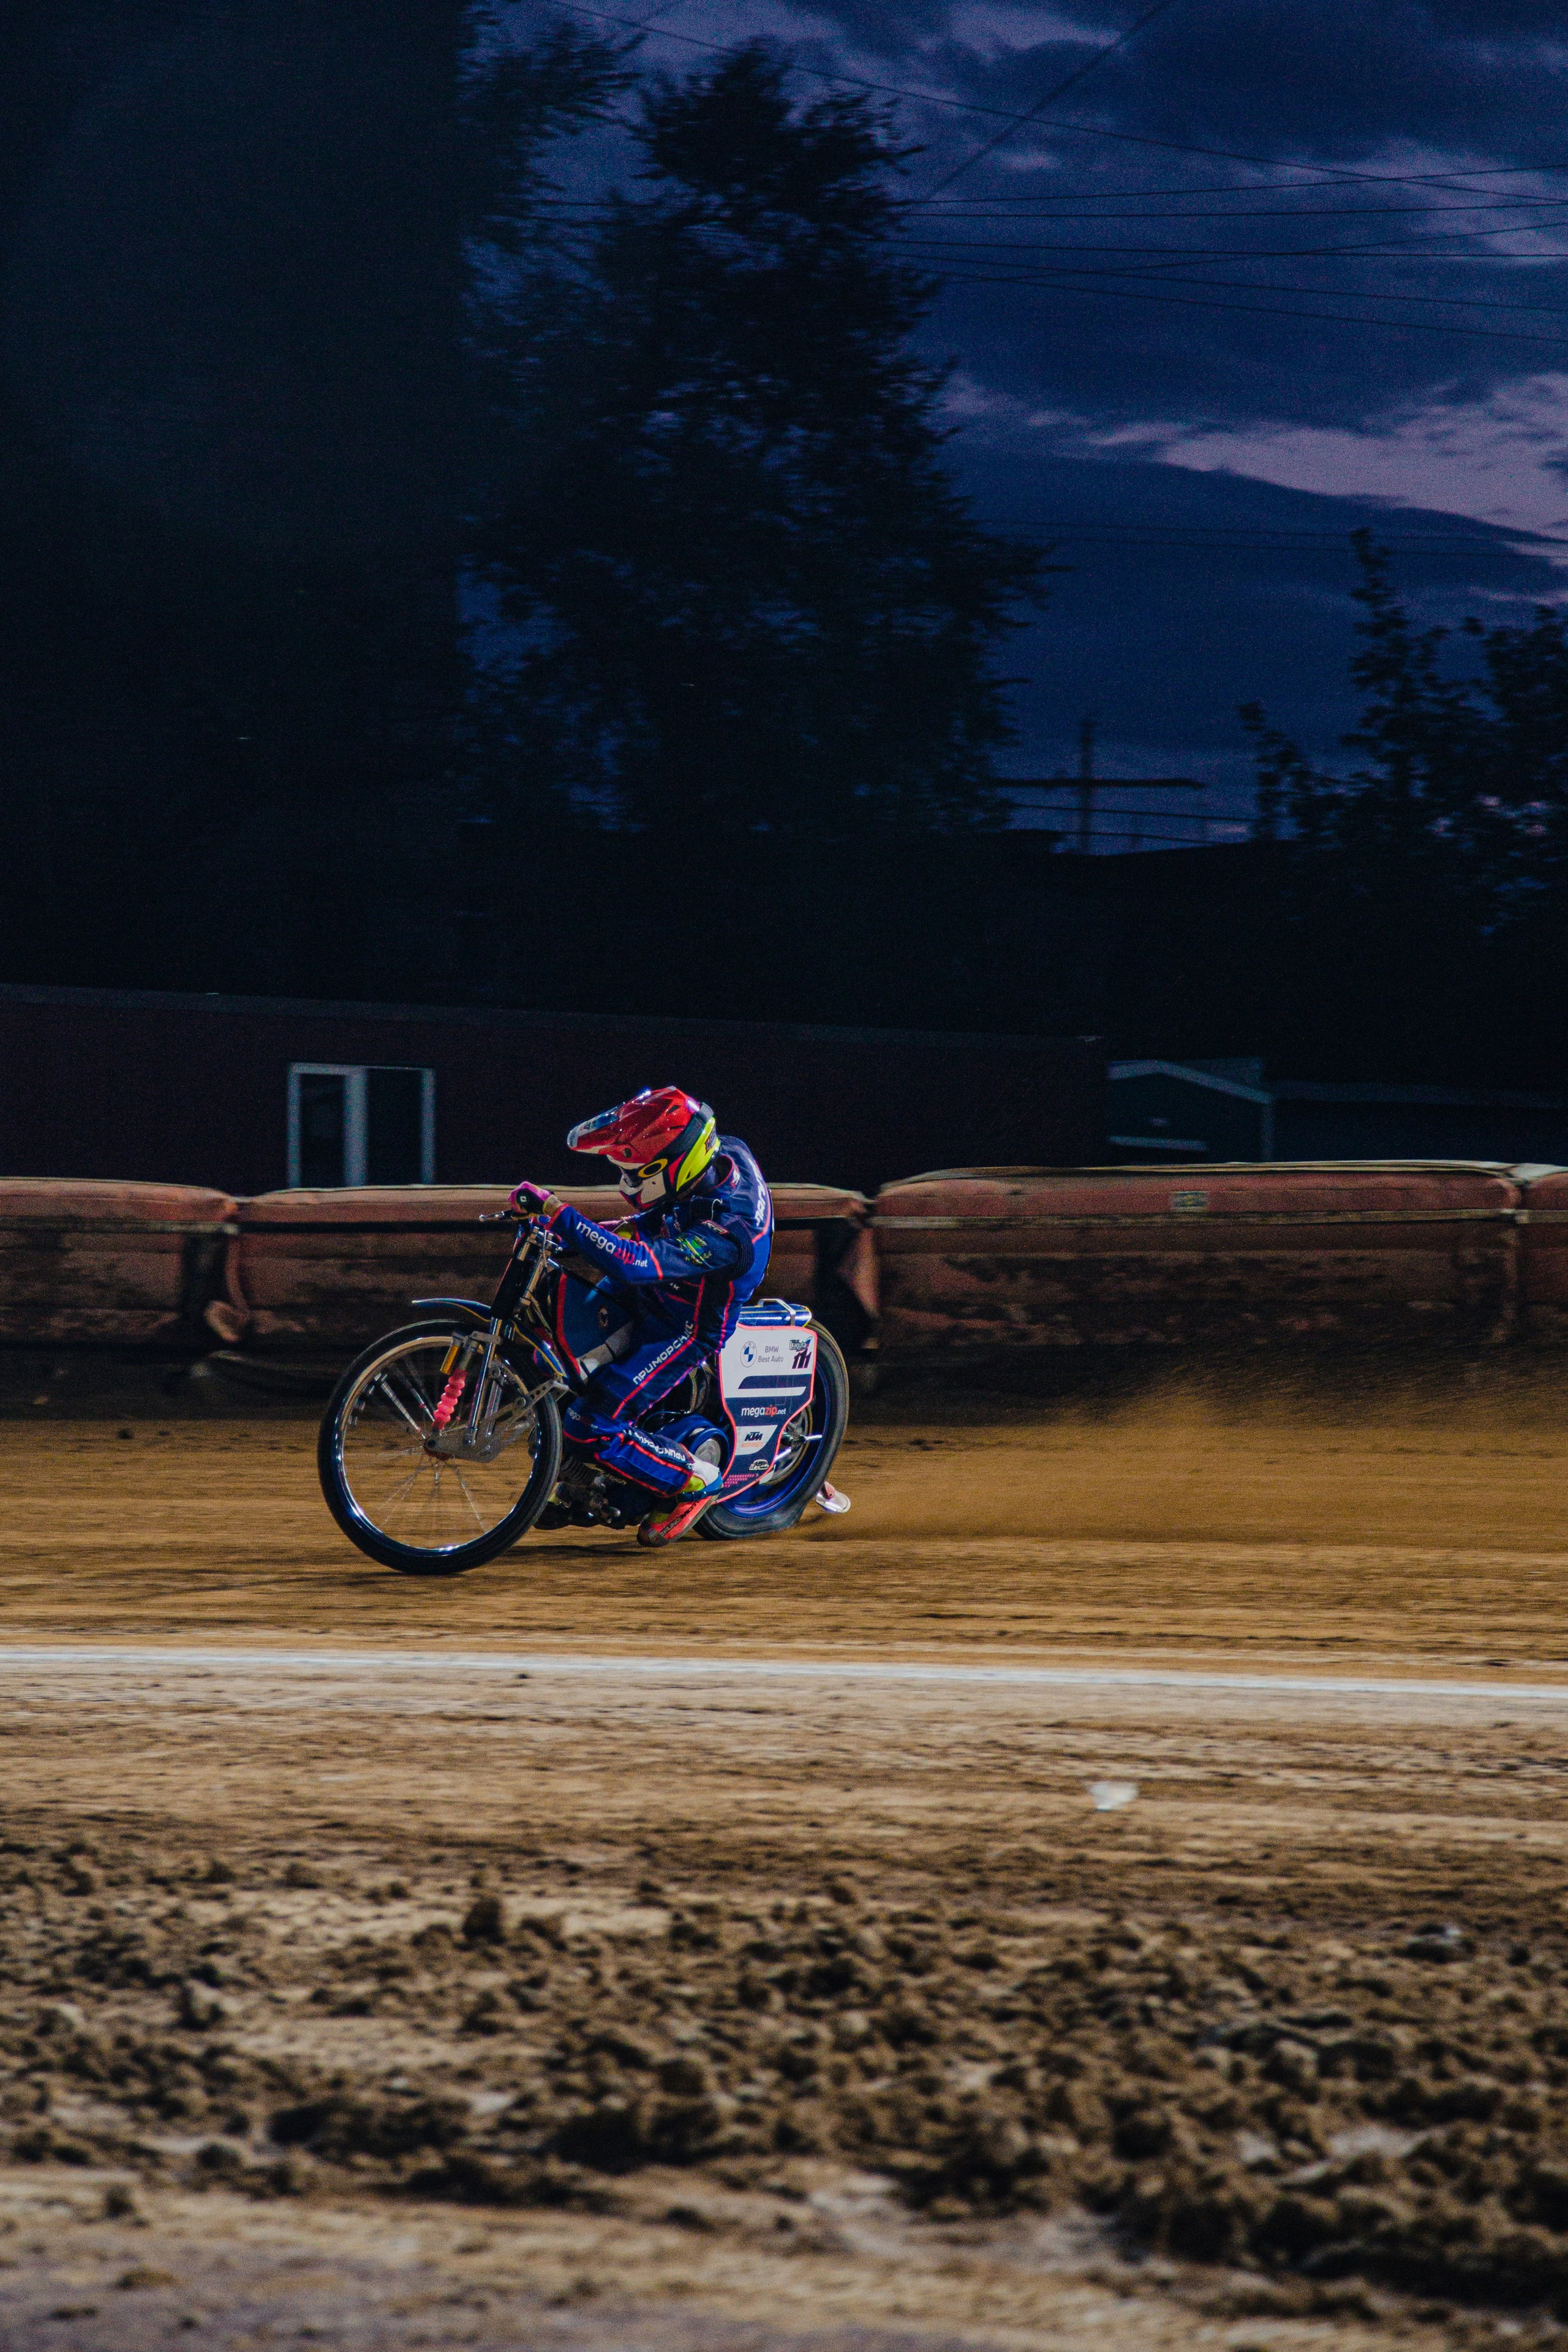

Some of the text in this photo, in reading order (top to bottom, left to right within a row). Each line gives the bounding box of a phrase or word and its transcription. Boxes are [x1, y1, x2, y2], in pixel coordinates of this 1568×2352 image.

[576, 1221, 649, 1267] megazip.net
[792, 1348, 812, 1369] 111
[741, 1404, 786, 1417] megazip.net
[744, 1431, 763, 1441] KTM
